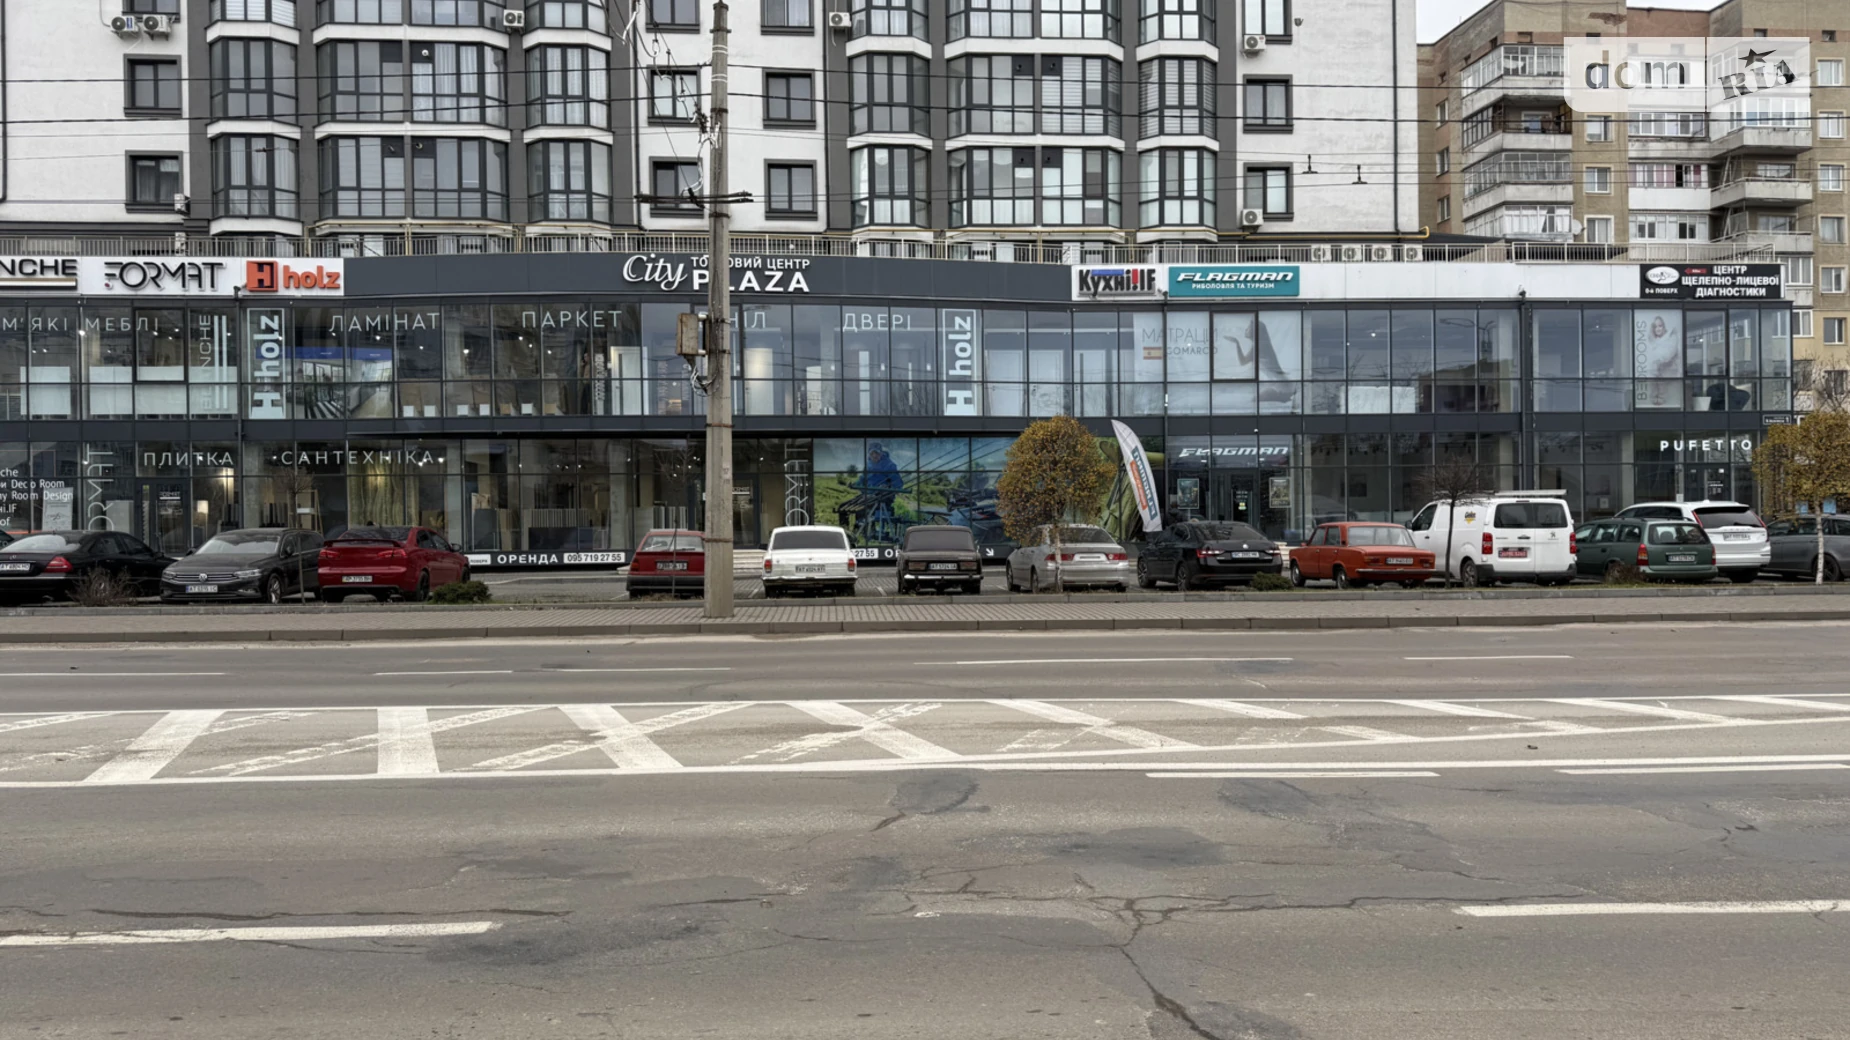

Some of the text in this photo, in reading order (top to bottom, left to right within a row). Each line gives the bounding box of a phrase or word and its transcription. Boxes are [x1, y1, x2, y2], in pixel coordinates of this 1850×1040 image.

[690, 254, 810, 270] ТООВИЙ ЦЕНТР
[622, 253, 810, 292] City PAZA
[1177, 272, 1294, 282] FLAGMAN
[1713, 265, 1748, 275] ЦЕНТР
[283, 265, 341, 290] holz
[1681, 274, 1779, 286] ЩЕЛЕПНО-ЛИЦЕВОЇ
[1695, 287, 1766, 298] ДІАГНОСТИКИ
[85, 317, 159, 331] МЕБЛІ
[329, 312, 440, 332] ЛАМІНАТ
[522, 310, 622, 328] ПАРКЕТ
[842, 312, 912, 332] ДВЕРІ
[253, 315, 280, 376] holz
[948, 316, 972, 375] holz
[1636, 320, 1648, 401] BEDROOMS
[1179, 447, 1288, 457] FLAGMAN
[1660, 440, 1752, 451] PUFETTO
[144, 452, 233, 466] ПЛИТКА
[281, 450, 434, 465] САНТЕХНІКА
[40, 479, 65, 488] Room
[12, 490, 39, 500] Room
[44, 490, 73, 502] Design
[497, 553, 558, 564] ОРЕНДА
[600, 553, 610, 561] 27
[612, 553, 621, 561] 55
